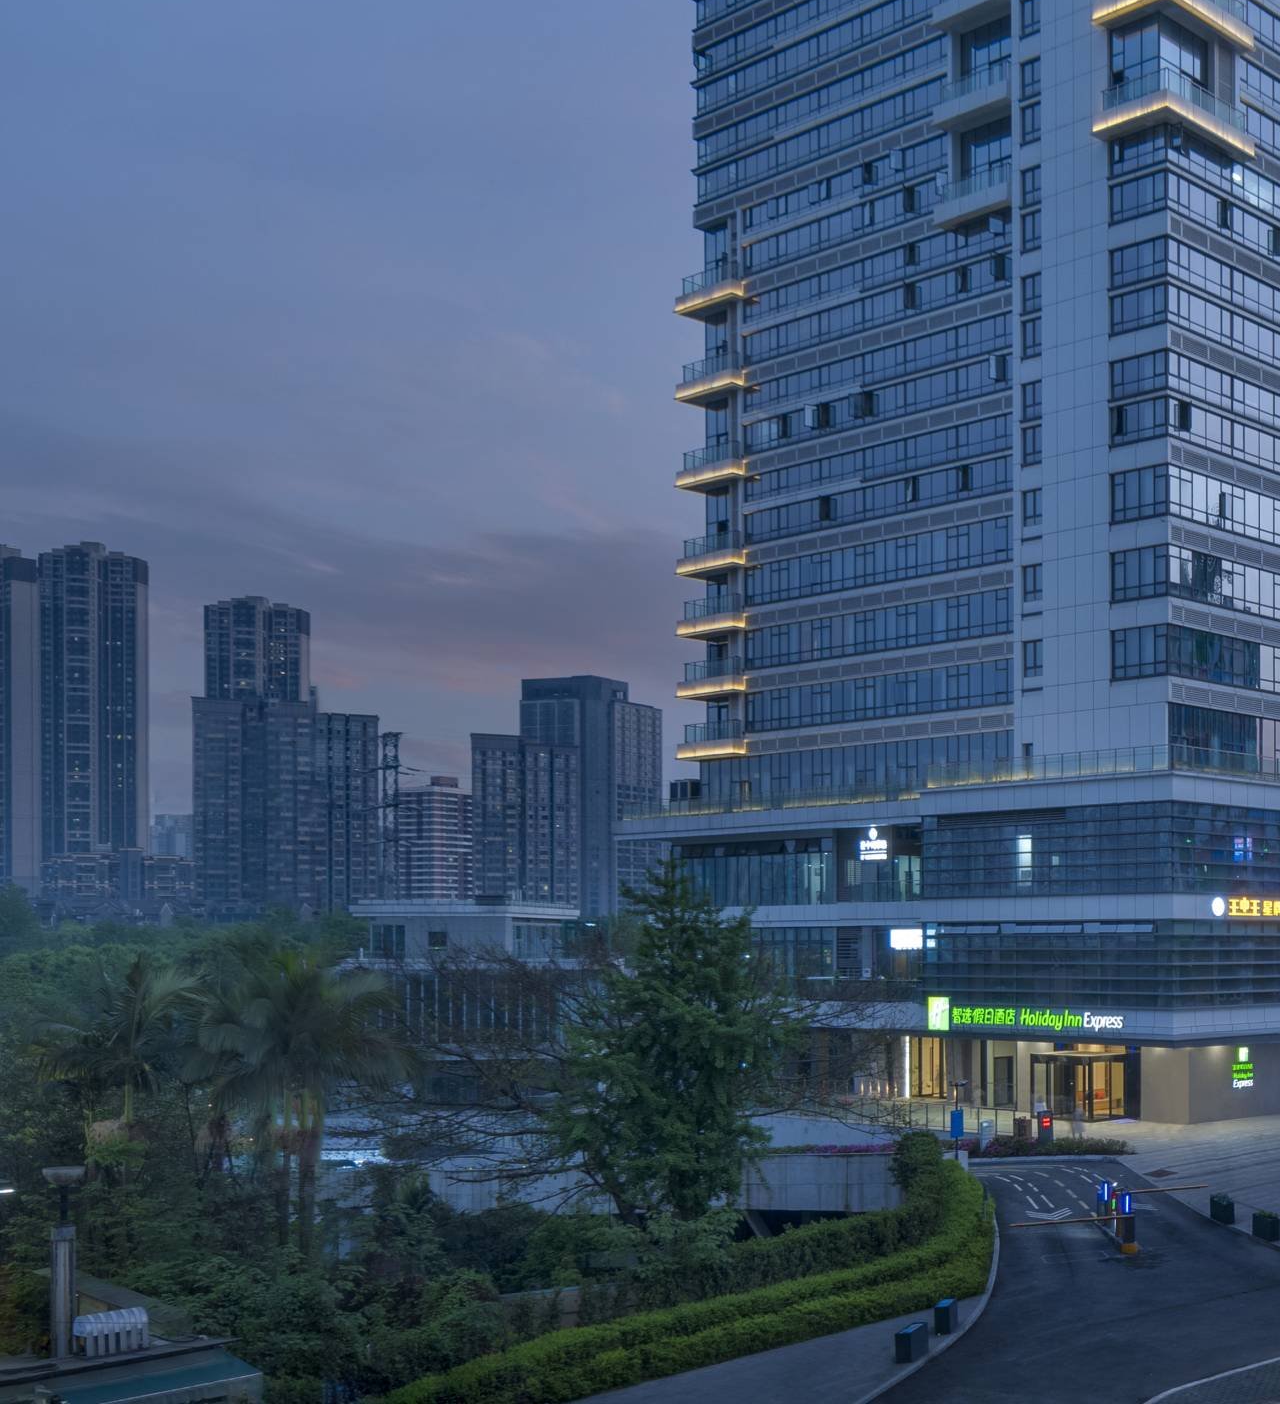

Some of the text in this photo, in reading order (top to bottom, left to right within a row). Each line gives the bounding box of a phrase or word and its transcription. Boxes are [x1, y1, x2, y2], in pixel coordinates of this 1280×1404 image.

[952, 1007, 1124, 1032] 智选假日酒店 Holiday Inn Express
